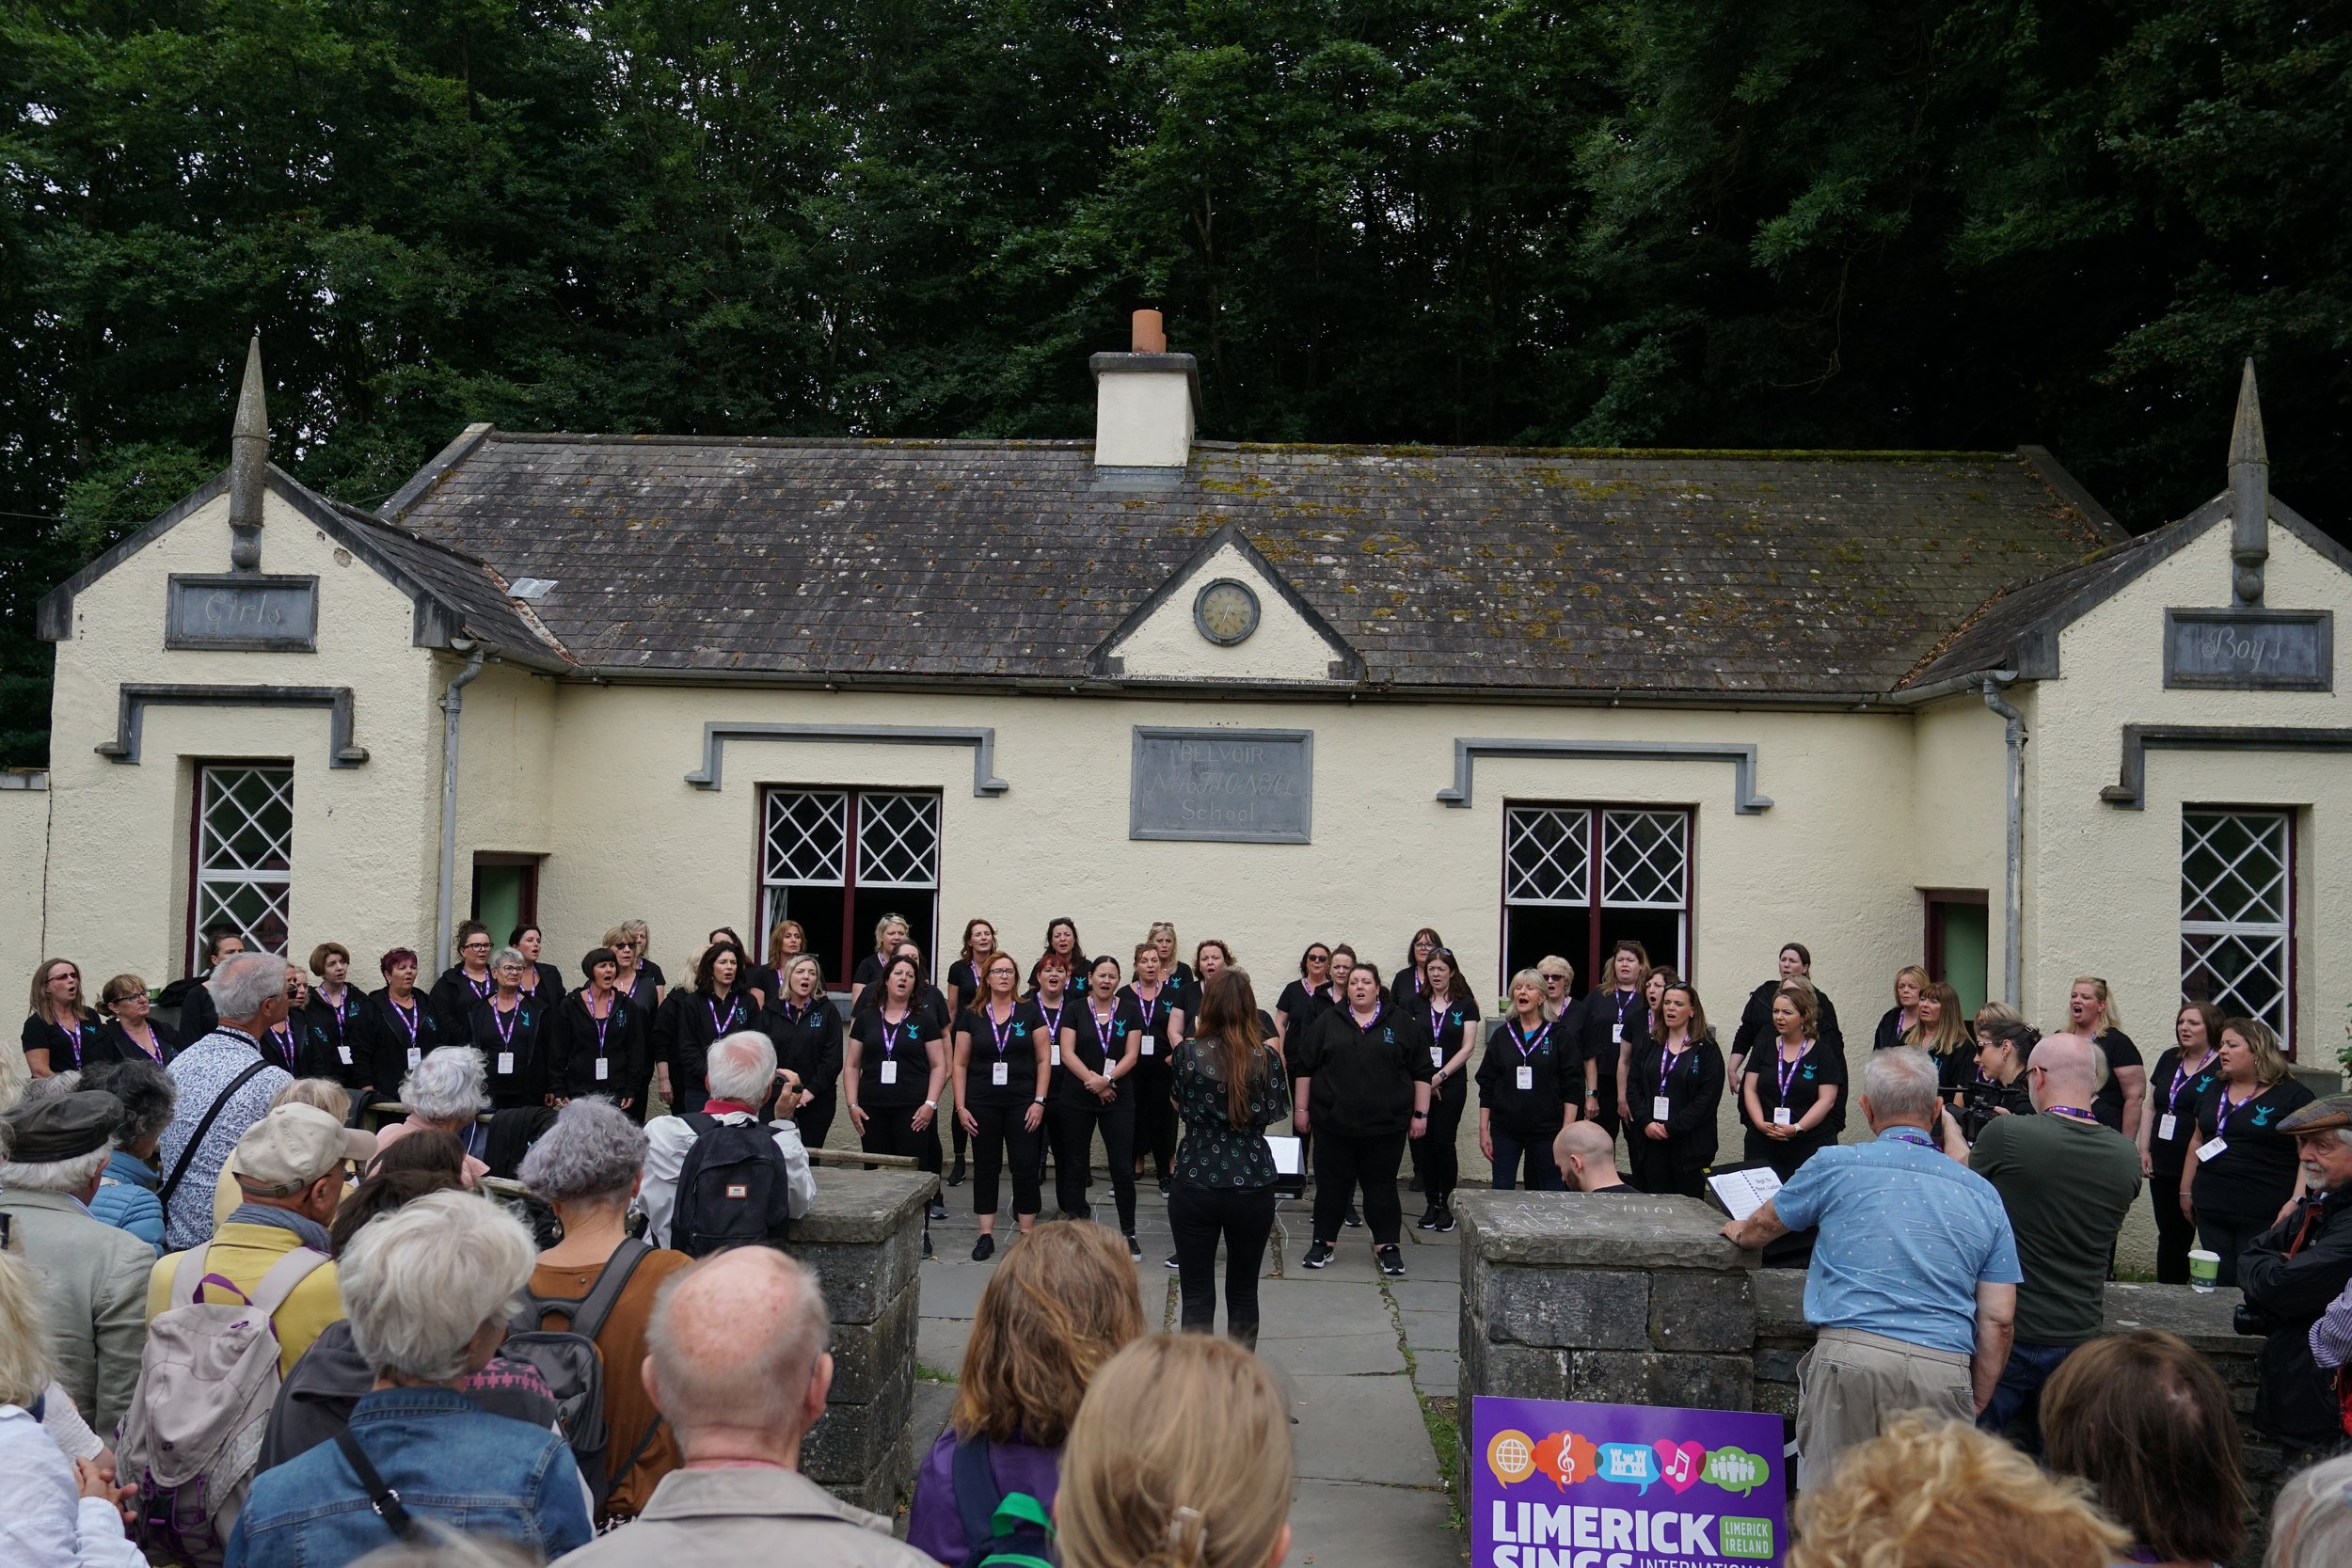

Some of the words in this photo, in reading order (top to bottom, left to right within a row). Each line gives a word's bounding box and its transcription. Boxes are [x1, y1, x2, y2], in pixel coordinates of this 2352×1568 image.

[205, 592, 280, 634] Girls
[2201, 626, 2288, 673] Boys
[1180, 744, 1264, 763] BELVOIR
[1143, 770, 1295, 798] NATIONAL
[1181, 798, 1256, 822] School
[1492, 1499, 1719, 1557] LIMERICK
[1724, 1521, 1769, 1538] LIMERICK
[1725, 1537, 1769, 1554] IRELAND
